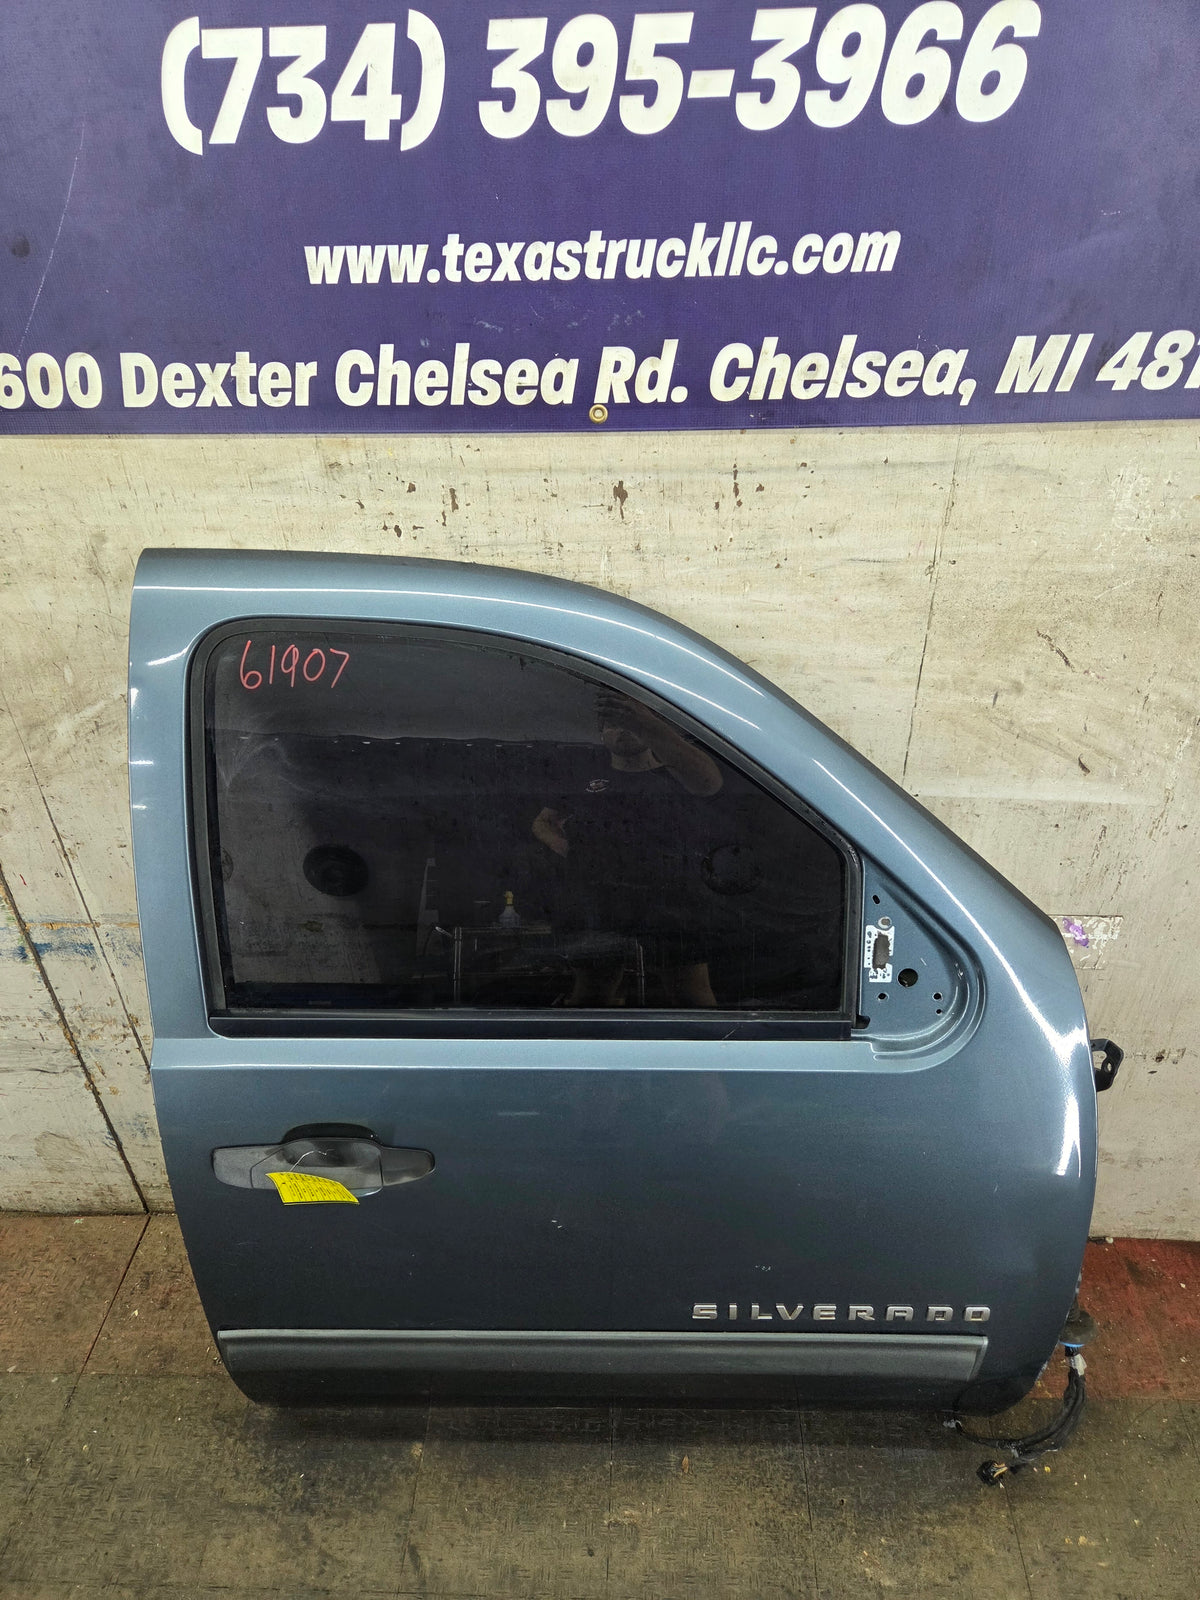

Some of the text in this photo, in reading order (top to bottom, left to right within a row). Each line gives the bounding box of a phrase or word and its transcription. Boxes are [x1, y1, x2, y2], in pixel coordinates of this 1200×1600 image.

[161, 0, 1042, 156] (734) 395-3966
[304, 221, 902, 285] www.texastruckllc.com
[0, 352, 103, 410] 600
[119, 350, 318, 408] Dexter
[334, 343, 580, 407] Chelsea
[593, 338, 689, 404] Rd.
[709, 334, 977, 406] Chelsea,
[994, 333, 1095, 395] MI
[240, 640, 350, 689] 61907
[691, 1302, 991, 1322] SILVERADO
